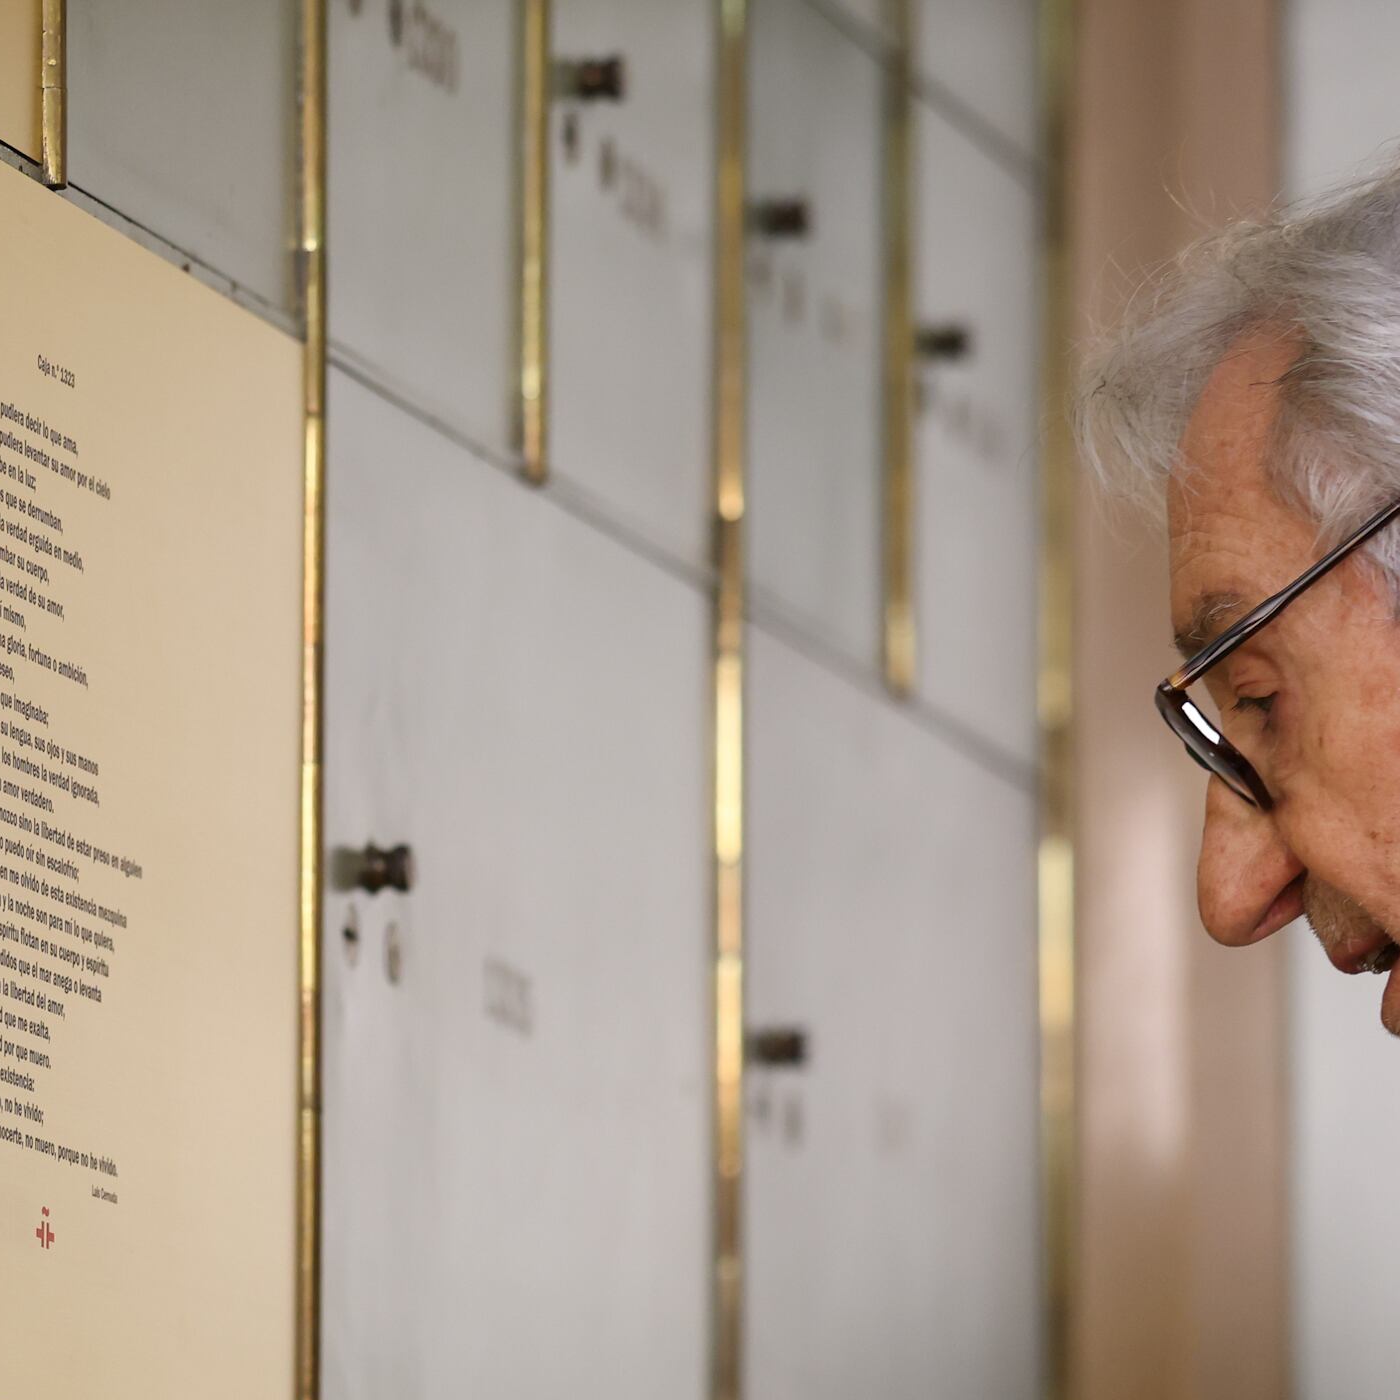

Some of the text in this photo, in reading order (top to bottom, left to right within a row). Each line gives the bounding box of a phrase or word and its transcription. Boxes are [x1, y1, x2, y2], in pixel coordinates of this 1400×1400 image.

[37, 354, 50, 376] Caja
[60, 367, 75, 388] 1323
[0, 402, 24, 429] pudiera
[25, 412, 41, 434] decir
[42, 420, 48, 439] lo
[50, 429, 61, 446] que
[0, 430, 23, 455] pudiera
[24, 439, 49, 468] levantar
[51, 457, 58, 473] su
[60, 463, 75, 481] amor
[77, 471, 87, 487] por
[88, 475, 94, 491] el
[96, 479, 110, 499] cielo
[8, 464, 16, 480] en
[17, 464, 24, 483] la
[5, 491, 17, 511] que
[18, 498, 26, 515] se
[6, 520, 27, 543] verdad
[28, 531, 52, 555] erguida
[53, 545, 61, 560] en
[17, 555, 24, 570] su
[5, 578, 27, 600] verdad
[28, 586, 36, 605] de
[37, 593, 45, 609] su
[28, 643, 51, 669] fortuna
[0, 692, 12, 711] que
[0, 721, 8, 736] su
[34, 736, 45, 752] sus
[46, 739, 59, 762] ojos
[65, 750, 76, 766] sus
[78, 755, 98, 775] manos
[1, 745, 11, 766] los
[12, 751, 39, 778] hombres
[41, 763, 47, 782] la
[48, 768, 69, 791] verdad
[3, 780, 19, 798] amor
[4, 835, 24, 858] puedo
[25, 843, 34, 862] oír
[35, 848, 45, 867] sin
[18, 959, 30, 977] que
[31, 961, 38, 979] el
[39, 967, 51, 983] mar
[53, 972, 72, 994] anega
[79, 978, 101, 1002] levanta
[4, 1011, 16, 1031] que
[17, 1016, 27, 1031] me
[3, 1040, 14, 1057] por
[15, 1044, 28, 1062] que
[4, 1098, 12, 1113] no
[14, 1097, 22, 1117] he
[25, 1134, 33, 1148] no
[57, 1145, 79, 1165] porque
[80, 1153, 88, 1167] no
[89, 1152, 97, 1170] he
